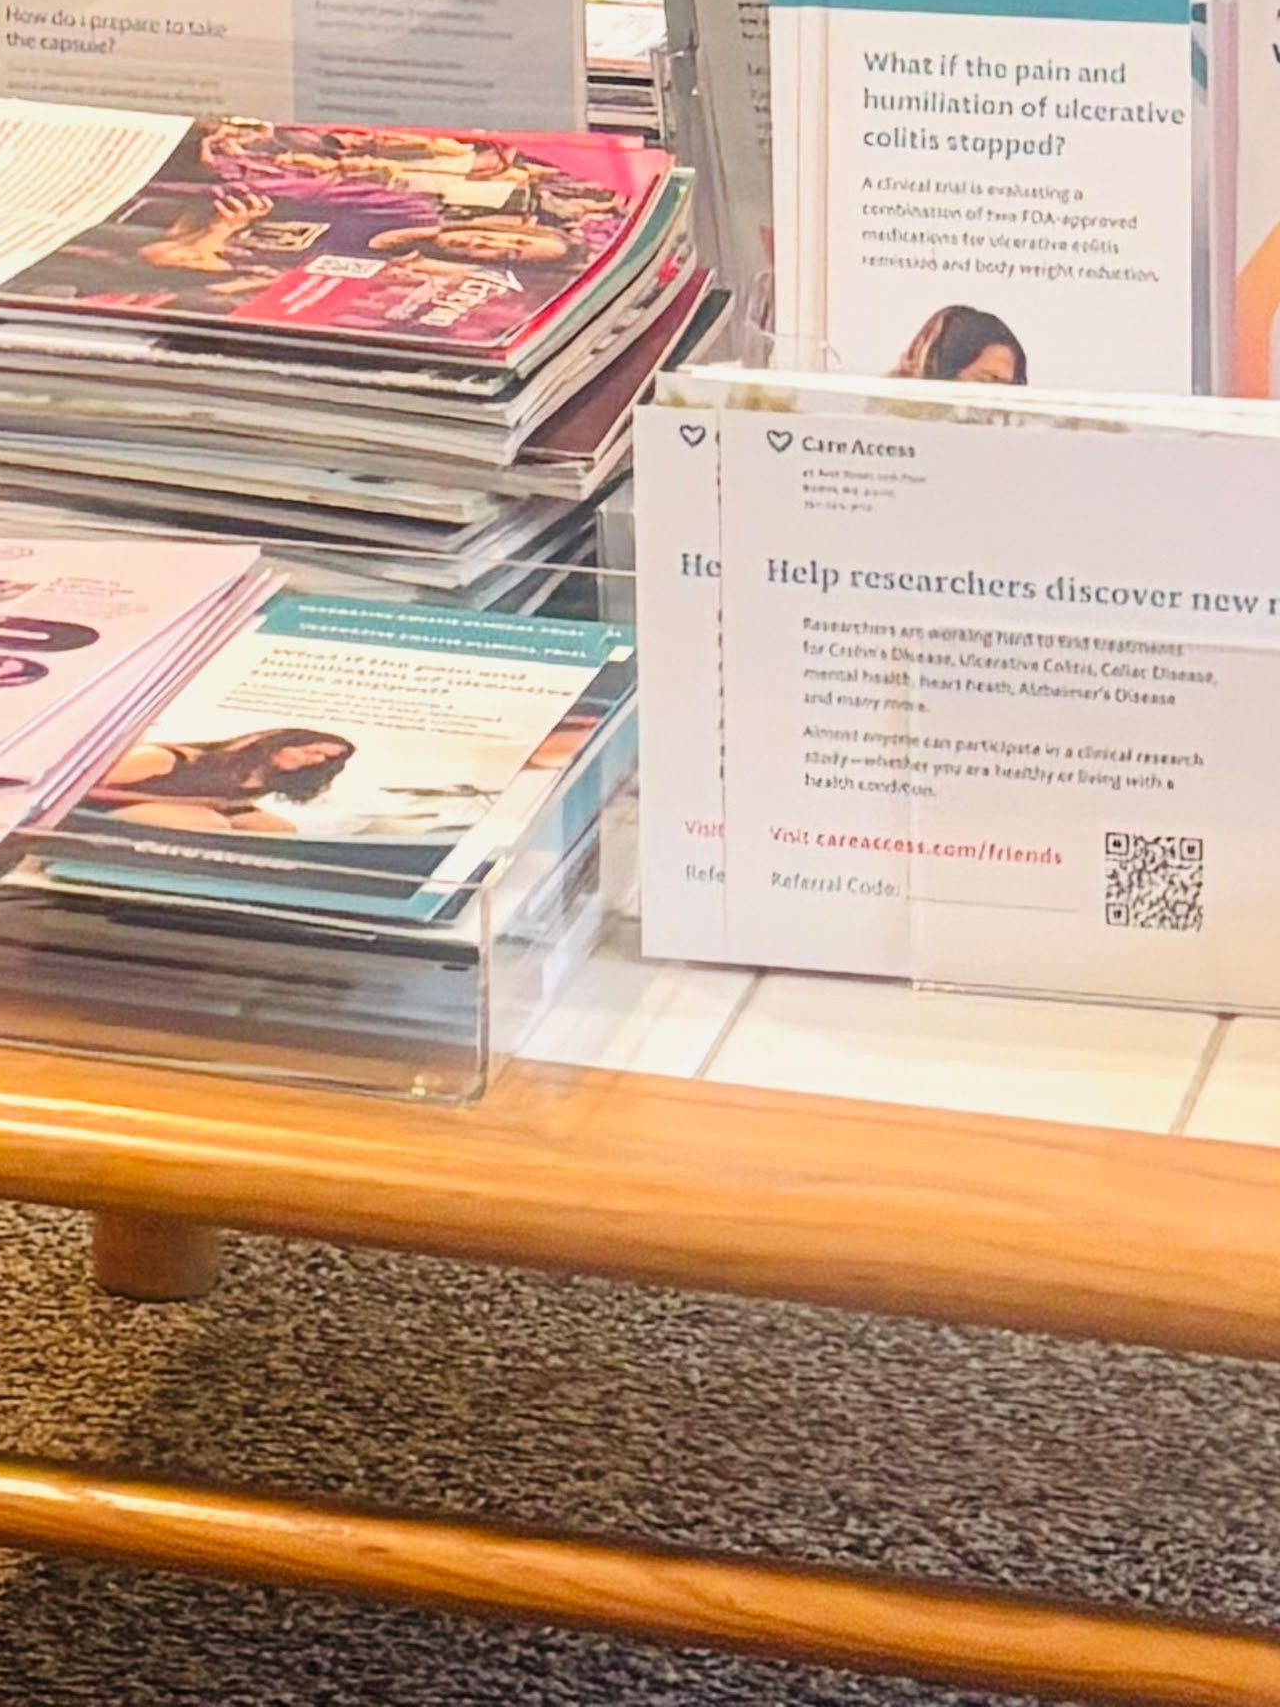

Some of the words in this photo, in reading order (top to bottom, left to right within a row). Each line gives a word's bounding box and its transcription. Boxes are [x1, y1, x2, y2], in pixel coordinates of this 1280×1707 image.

[6, 5, 46, 25] How
[51, 10, 76, 28] do
[90, 14, 161, 35] prepare
[166, 19, 185, 35] to
[189, 20, 228, 38] take
[6, 31, 36, 51] the
[41, 37, 117, 55] capsule?
[864, 51, 933, 76] What
[940, 54, 957, 77] if
[965, 56, 1008, 78] the
[1016, 58, 1070, 85] pain
[1077, 63, 1127, 84] and
[863, 86, 1013, 117] humiliation
[1021, 95, 1049, 118] of
[1055, 98, 1186, 125] ulcerative
[863, 127, 939, 150] colitis
[947, 131, 1066, 160] stopped?
[861, 176, 873, 190] A
[877, 177, 931, 193] clinical
[935, 179, 967, 195] trial
[970, 181, 983, 195] is
[987, 182, 1070, 204] evaluating
[1073, 189, 1084, 201] a
[861, 202, 962, 220] combination
[965, 206, 986, 221] of
[962, 231, 985, 248] for
[942, 255, 971, 272] and
[975, 258, 1015, 278] body
[1019, 261, 1074, 282] weight
[802, 436, 848, 454] Care
[851, 440, 917, 458] Access
[680, 553, 722, 578] He
[767, 558, 840, 593] Help
[850, 568, 1037, 601] researchers
[1045, 575, 1183, 610] discover
[1191, 591, 1259, 615] new
[803, 639, 824, 655] for
[959, 654, 1039, 673] Ulcerative
[803, 668, 858, 683] mental
[919, 675, 961, 691] heart
[1115, 688, 1176, 706] Disease
[804, 691, 833, 706] and
[923, 736, 951, 749] can
[1064, 747, 1073, 758] a
[1077, 745, 1132, 762] clinical
[1136, 752, 1204, 767] research
[1126, 772, 1161, 788] with
[1166, 778, 1175, 790] a
[770, 825, 810, 847] Visit
[815, 831, 1064, 866] careaccess.com/friends
[686, 863, 726, 885] Refe
[771, 871, 842, 893] Referral
